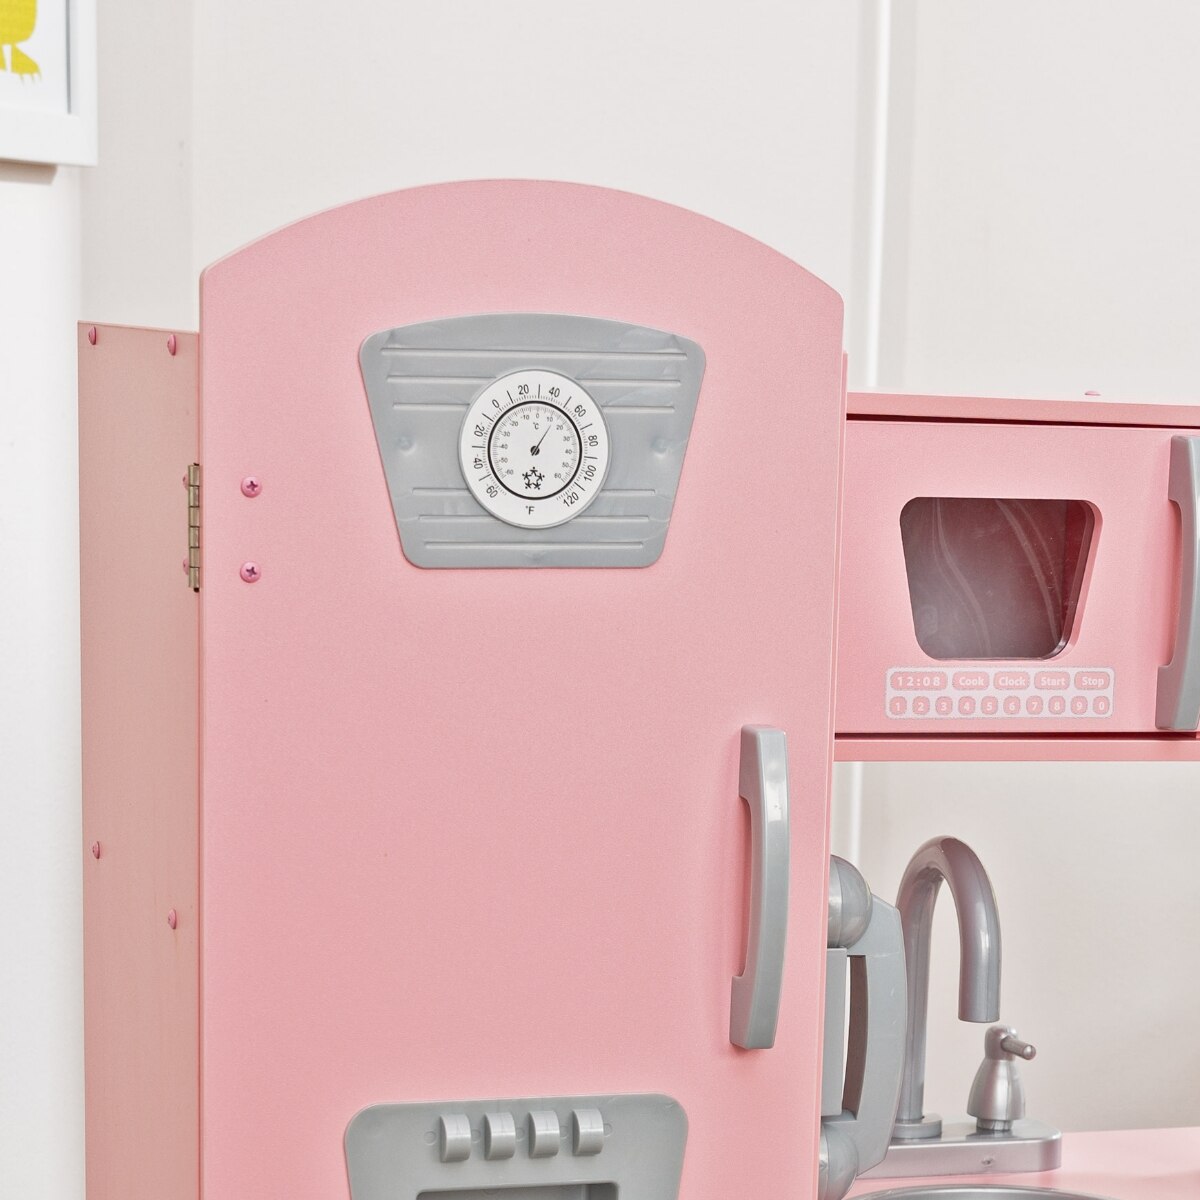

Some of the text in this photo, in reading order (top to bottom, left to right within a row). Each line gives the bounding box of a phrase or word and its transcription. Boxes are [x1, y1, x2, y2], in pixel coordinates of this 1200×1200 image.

[474, 384, 598, 507] -60 -40 -20 0 20 40 60 80 100 120
[959, 676, 984, 686] Cook
[999, 676, 1026, 686] Clock
[1041, 677, 1065, 686] Start
[1081, 676, 1104, 688] Stop
[896, 702, 1105, 711] 1 2 3 4 5 6 7 8 9 0
